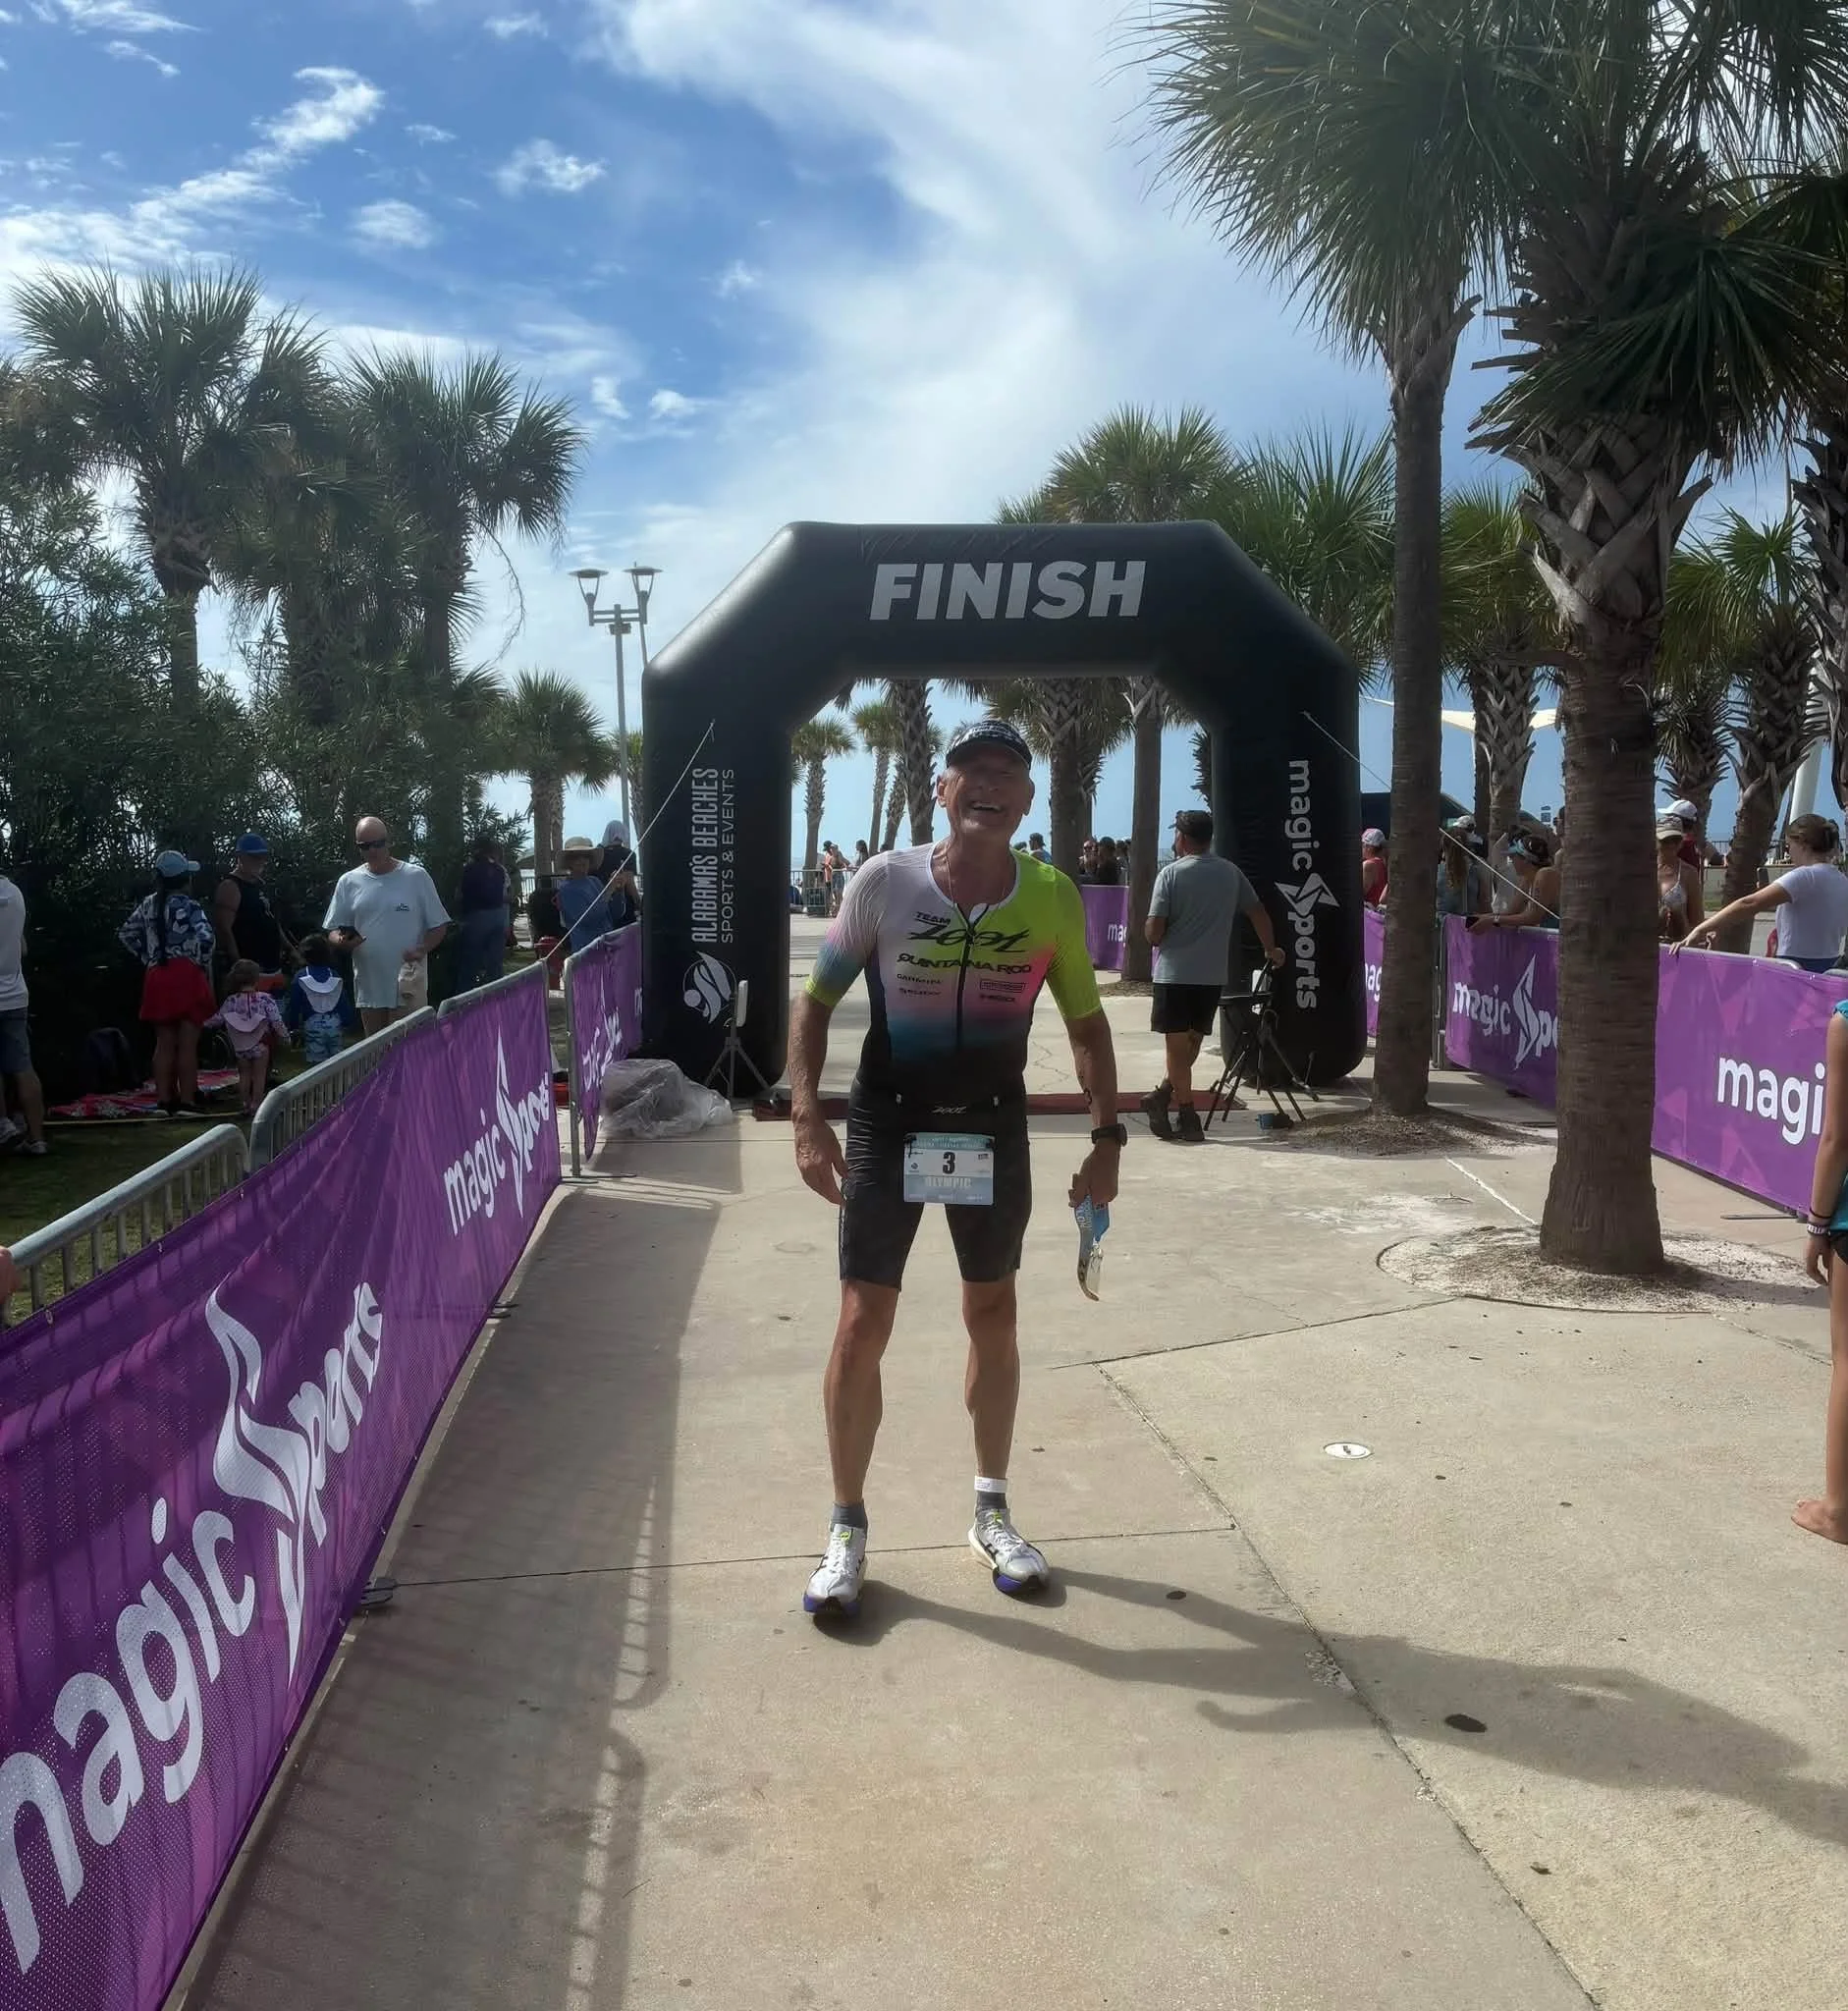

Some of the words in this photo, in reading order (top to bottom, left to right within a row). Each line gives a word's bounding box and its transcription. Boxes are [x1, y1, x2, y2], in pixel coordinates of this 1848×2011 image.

[869, 561, 1147, 621] FINISH
[692, 768, 719, 847] BEACHES
[722, 769, 734, 845] EVENTS
[1284, 759, 1320, 871] magic
[722, 849, 734, 862] &
[722, 868, 734, 943] SPORTS
[916, 911, 951, 926] TEAM
[1453, 982, 1511, 1037] magic
[1717, 1057, 1825, 1145] magi
[444, 1108, 506, 1236] magic
[942, 1151, 956, 1175] 3
[0, 1497, 255, 1976] magic
